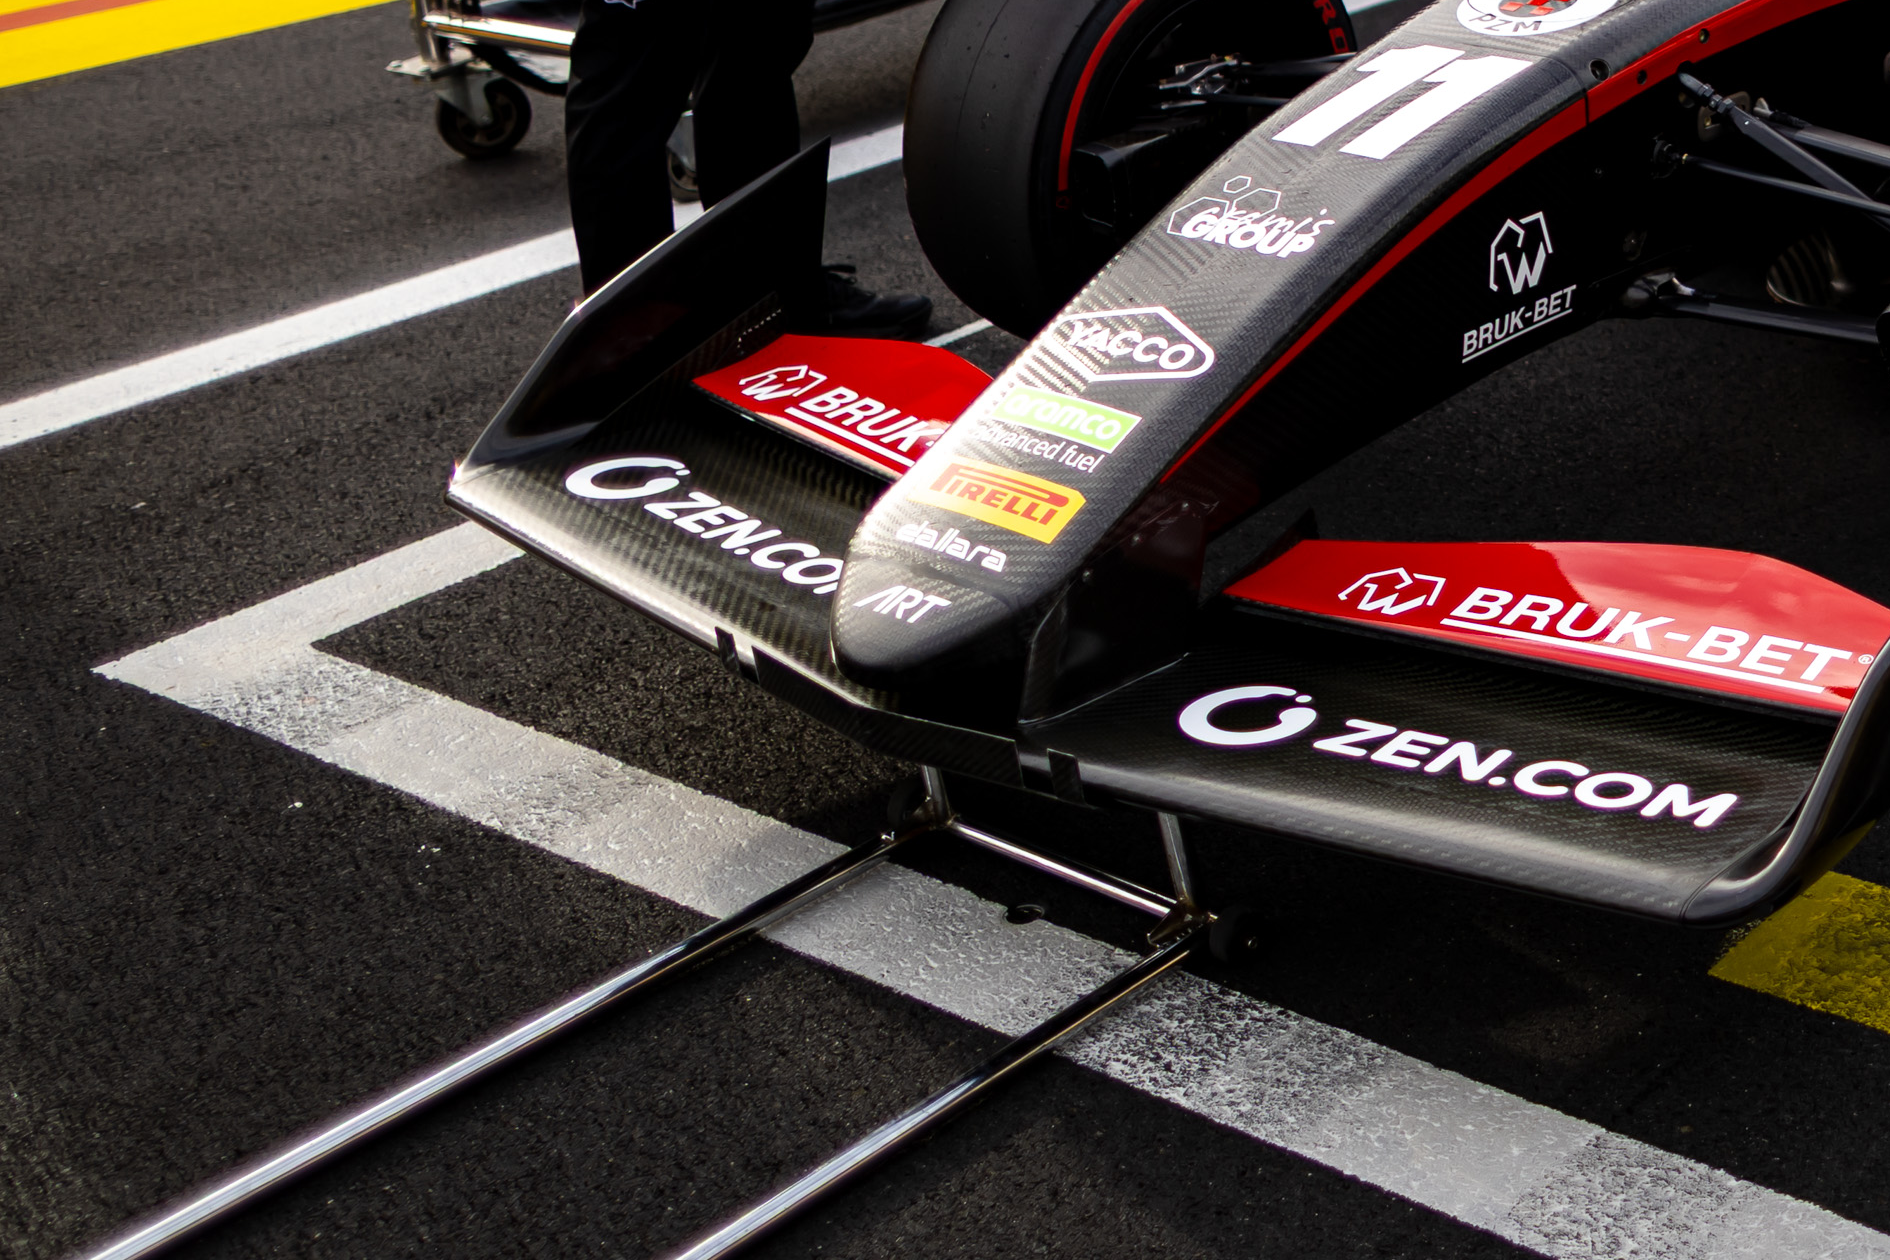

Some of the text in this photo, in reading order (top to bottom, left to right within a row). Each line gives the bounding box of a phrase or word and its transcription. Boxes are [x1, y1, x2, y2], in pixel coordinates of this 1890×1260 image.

[1469, 13, 1542, 33] PZM
[1272, 45, 1533, 160] 11
[1181, 207, 1315, 258] GROUP
[1071, 322, 1195, 371] YACCO
[1462, 285, 1577, 358] BRUK-BET
[1003, 391, 1122, 442] aramco
[1056, 443, 1105, 474] fuel
[929, 463, 1071, 526] PIRELLI
[644, 491, 844, 595] ZEN.CO
[896, 520, 1008, 573] dallara
[853, 586, 952, 624] ART
[1452, 586, 1854, 685] BRUK-BET
[1312, 717, 1741, 829] ZEN.COM
